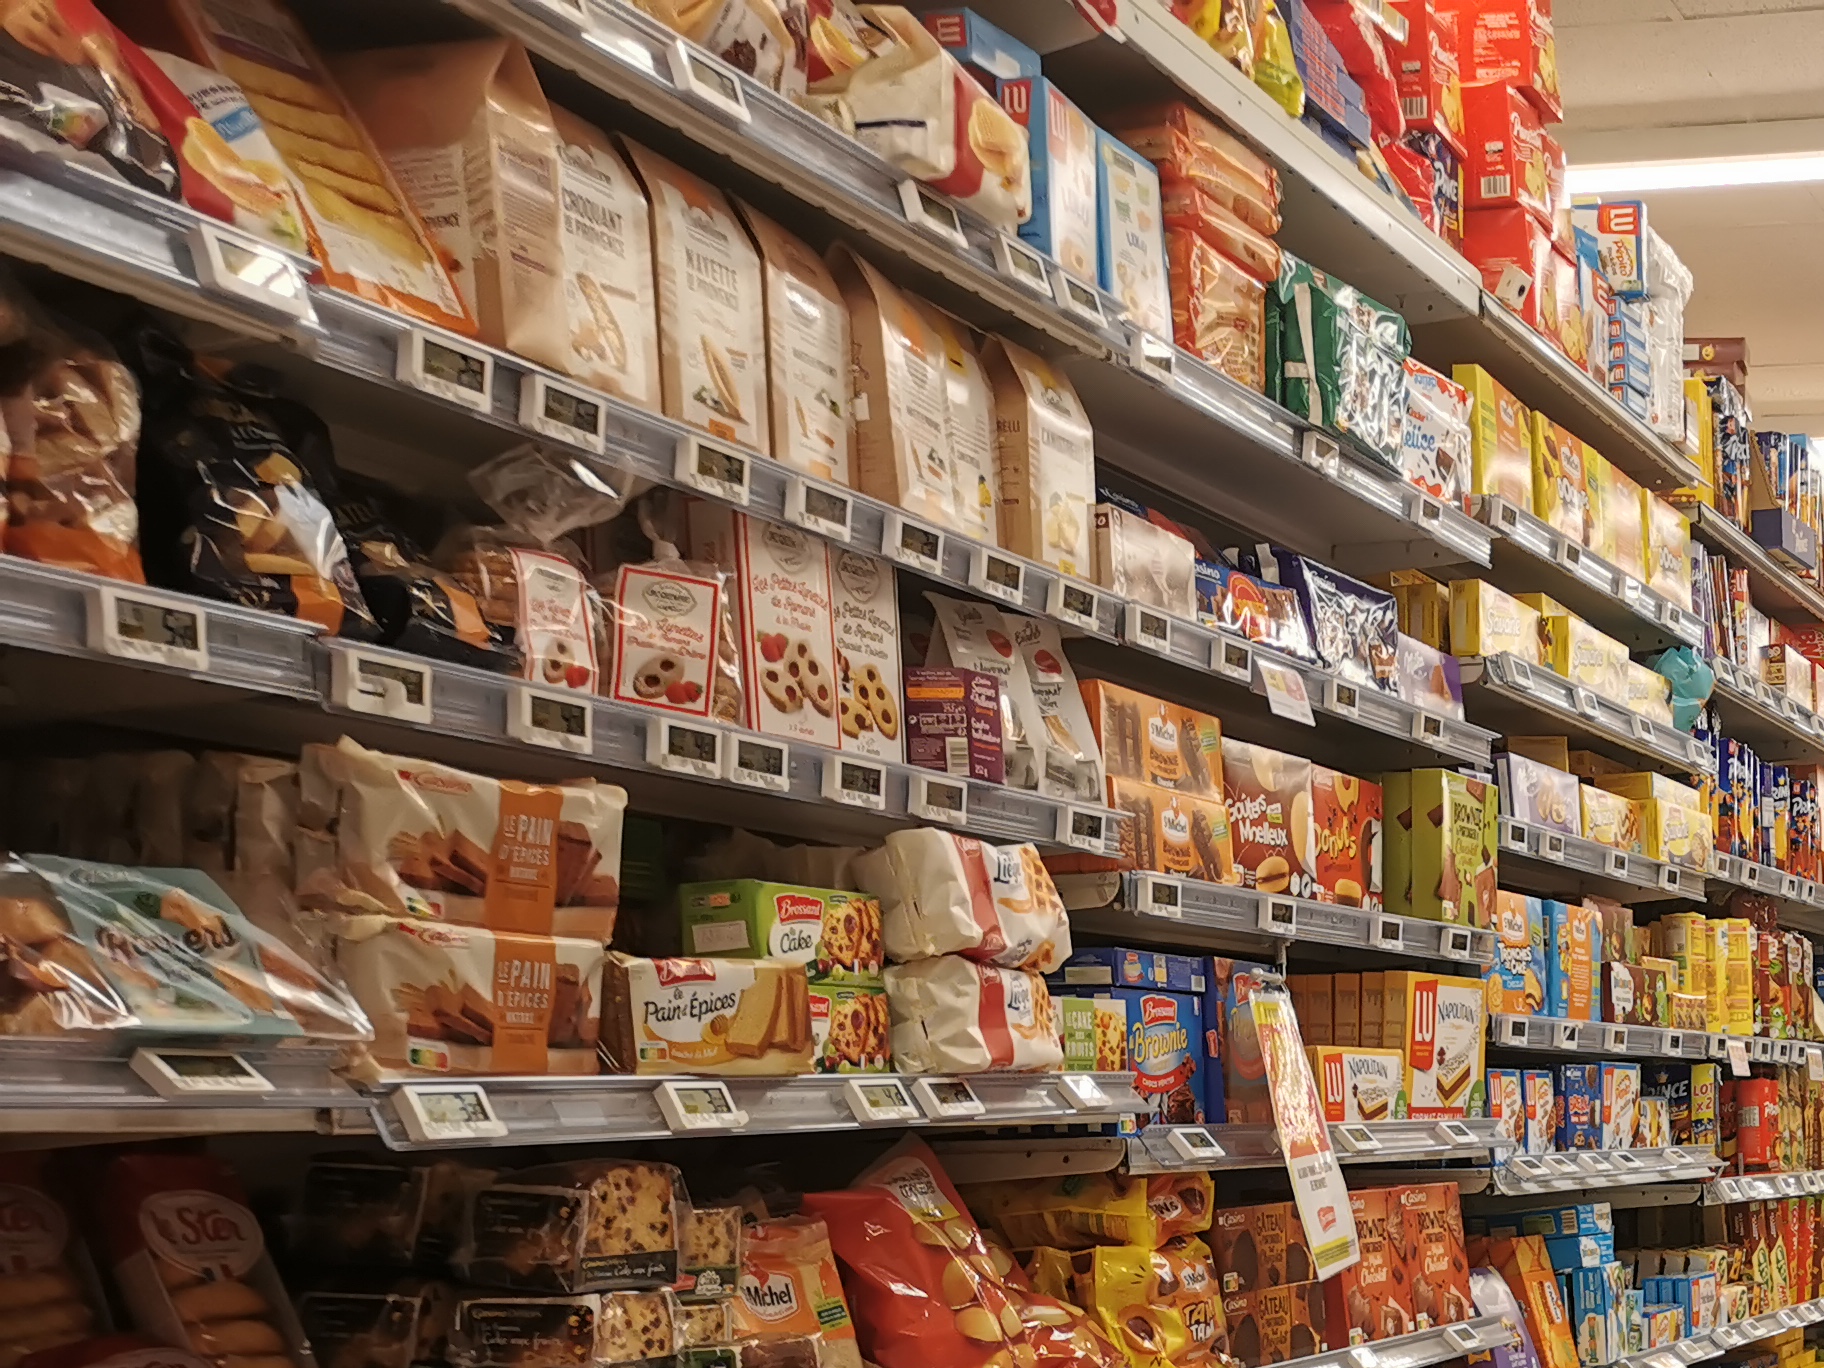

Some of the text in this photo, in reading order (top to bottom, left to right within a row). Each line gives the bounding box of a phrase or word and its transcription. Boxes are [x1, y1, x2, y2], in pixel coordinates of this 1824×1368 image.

[1003, 85, 1027, 114] LU
[1610, 207, 1635, 232] LU
[1486, 609, 1522, 637] Savane
[1454, 803, 1482, 830] BROWNIE
[518, 815, 554, 845] PAIN
[1240, 822, 1288, 846] Moelleux
[780, 899, 822, 920] Brossard
[780, 932, 813, 954] Cake
[510, 961, 550, 989] PAIN
[644, 1001, 681, 1025] Pain
[1415, 990, 1433, 1042] LU
[1438, 1001, 1475, 1025] NAPOLITAIN
[1132, 1027, 1188, 1064] Brownie
[1348, 1060, 1388, 1079] NAPOLITAIN
[1326, 1063, 1343, 1103] LU
[1693, 1083, 1714, 1097] LOT
[1405, 1190, 1428, 1205] Casino
[176, 1206, 247, 1246] Ster
[1223, 1212, 1246, 1228] Casino
[1361, 1267, 1388, 1287] Chocolat
[1425, 1257, 1450, 1275] Chocolat
[1224, 1298, 1248, 1314] Casino
